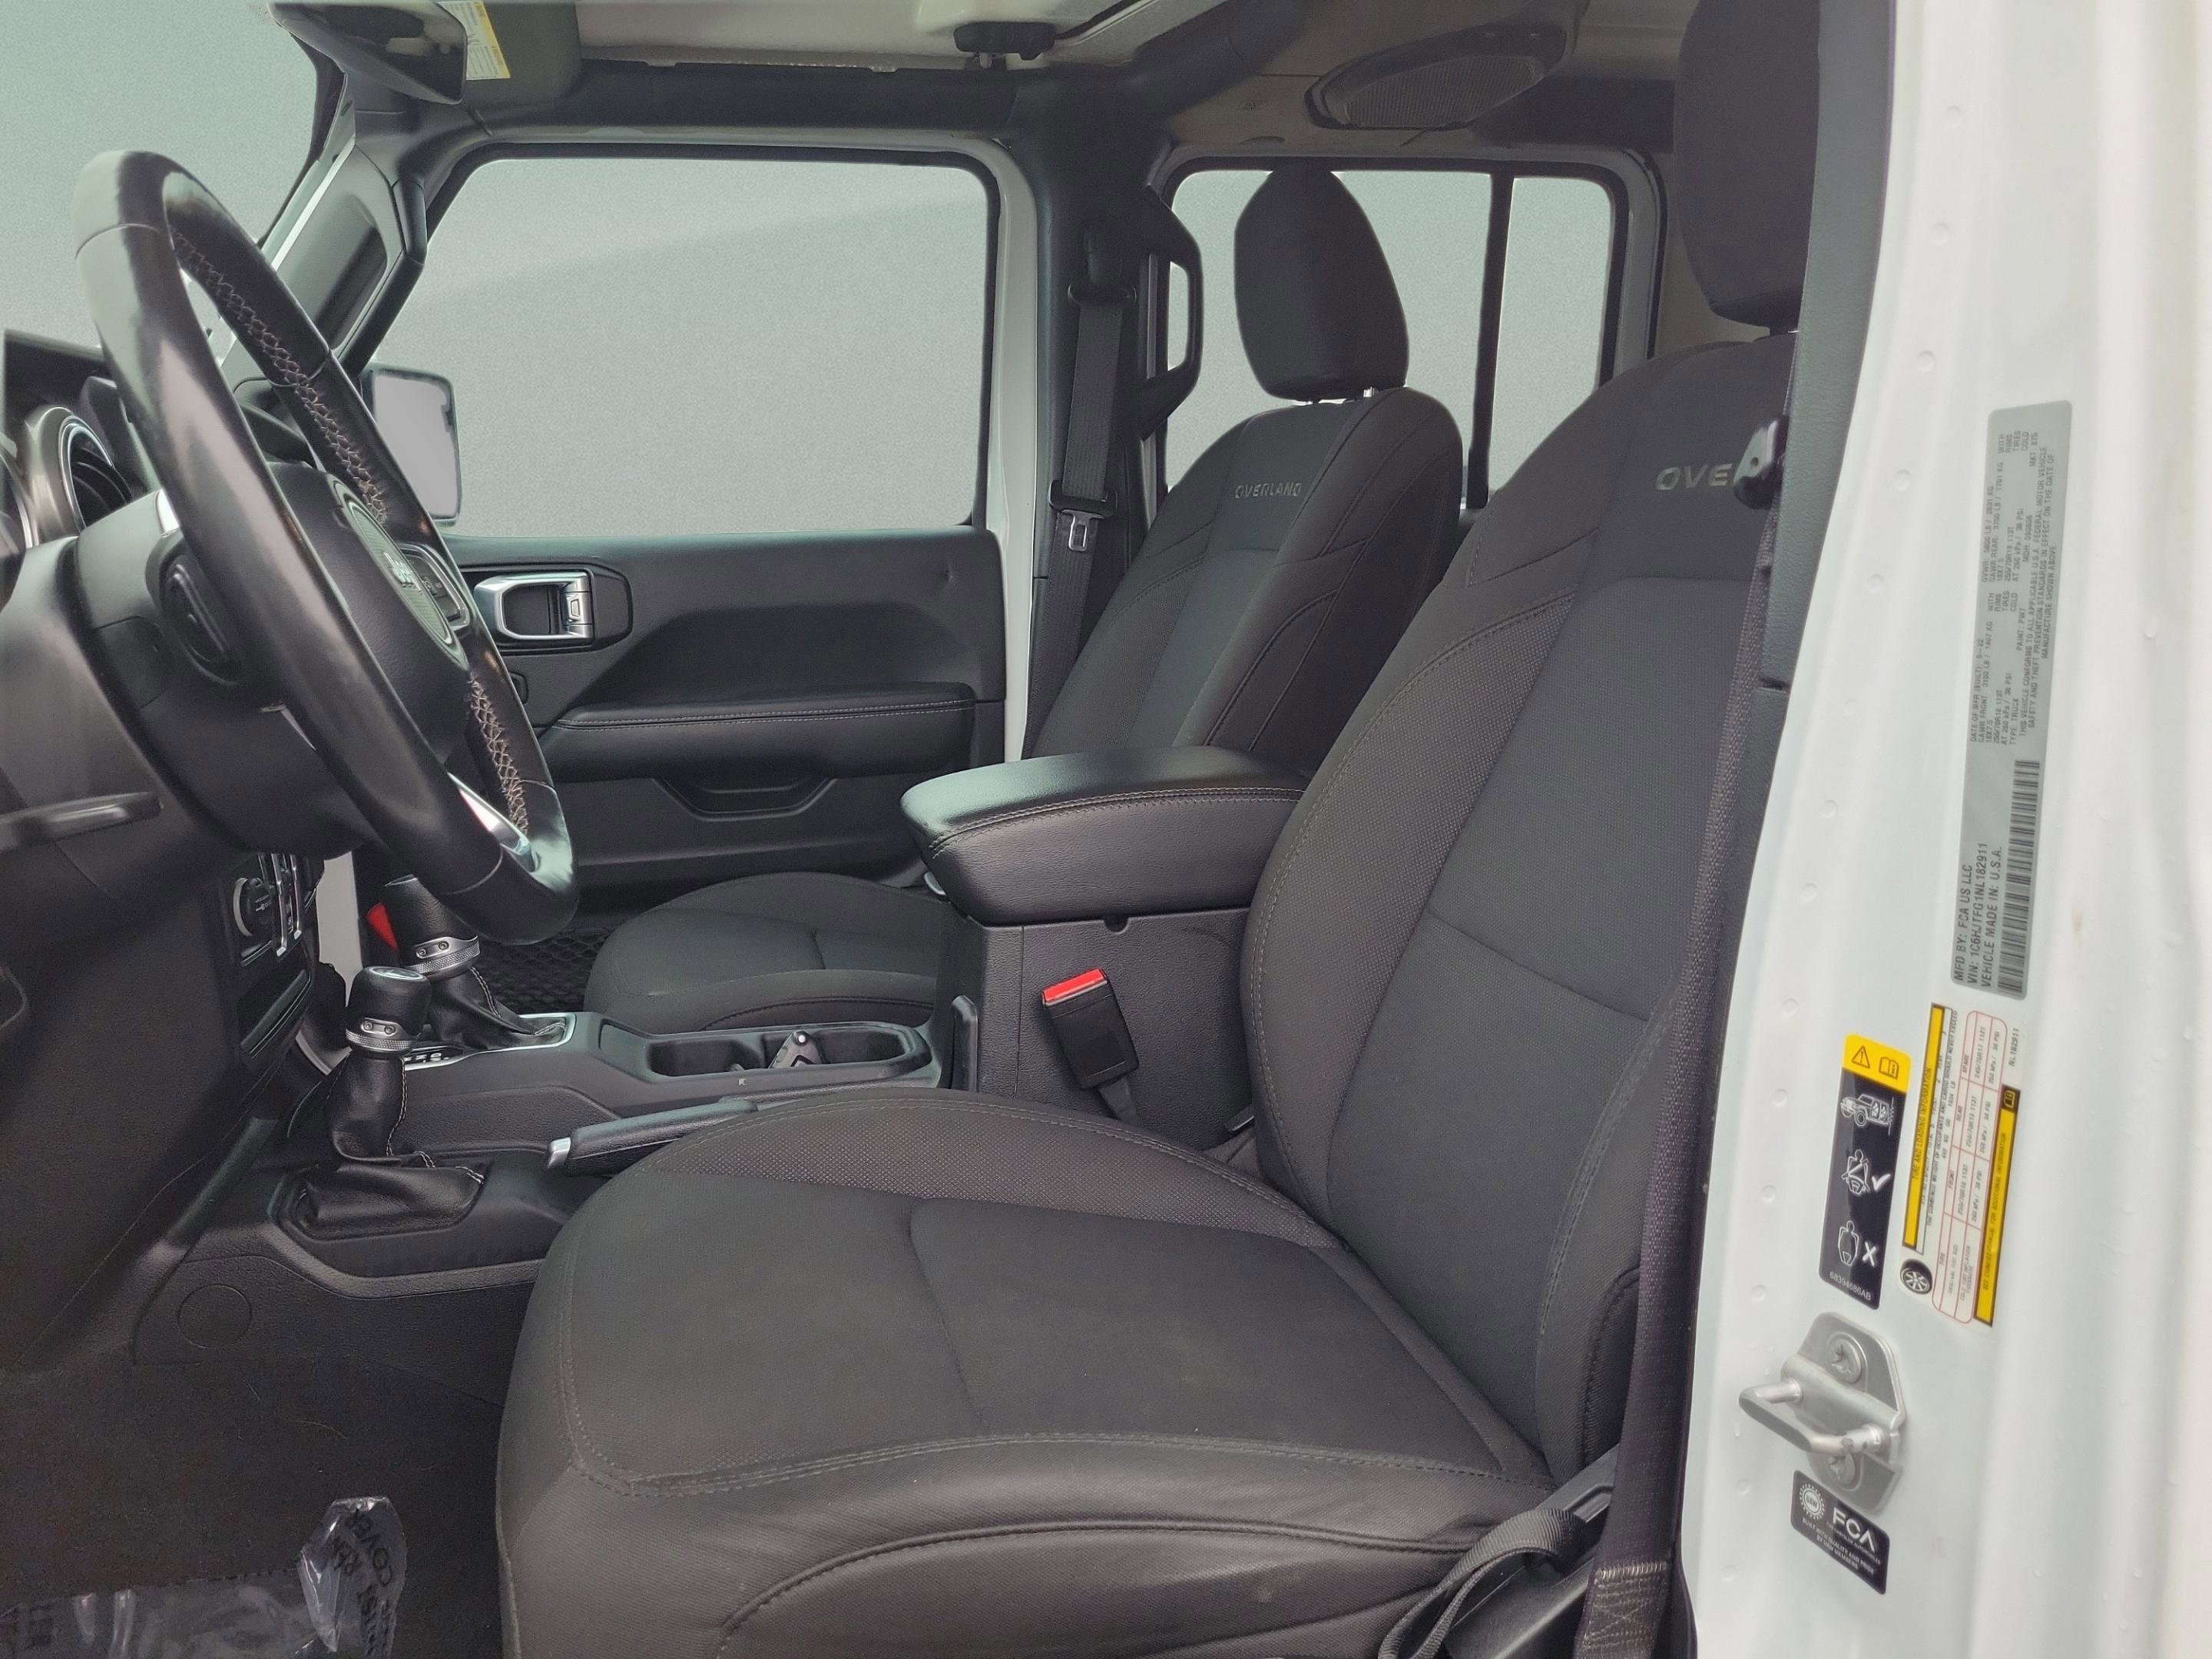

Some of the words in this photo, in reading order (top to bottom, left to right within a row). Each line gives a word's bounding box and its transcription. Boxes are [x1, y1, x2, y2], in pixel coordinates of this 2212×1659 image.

[2038, 446, 2046, 476] VEHICLE
[2047, 454, 2053, 463] OF
[1234, 482, 1302, 499] OVERLAND
[1655, 463, 1737, 491] OVE
[2043, 506, 2050, 515] ON
[2033, 510, 2041, 541] FEDERAL
[2041, 519, 2049, 546] EFFECT
[2028, 571, 2037, 614] APPLICABLE
[2037, 559, 2046, 604] STANDARDS
[2045, 573, 2054, 599] SHOWN
[2026, 634, 2032, 642] TO
[2033, 608, 2043, 653] PREVENTION
[2041, 603, 2051, 658] MANUFACTURE
[2022, 645, 2032, 685] CONFORMS
[1972, 712, 1979, 721] OF
[2020, 688, 2028, 717] VEHICLE
[2027, 700, 2036, 728] SAFETY
[1962, 864, 1972, 884] LLC
[1990, 846, 2002, 879] U.S.A.
[1960, 888, 1970, 902] US
[1970, 843, 1987, 957] 1C6HJTFG1NL182911
[1988, 885, 1998, 900] IN:
[1959, 906, 1969, 928] FCA
[1985, 904, 1997, 937] MADE
[1956, 933, 1967, 952] BY:
[1954, 955, 1965, 981] MFD
[1968, 961, 1978, 984] VIN:
[1982, 940, 1994, 988] VEHICLE
[2008, 1027, 2019, 1067] NL182911
[1919, 1067, 1932, 1115] INFORMATION
[1916, 1115, 1926, 1148] LOADING
[1913, 1147, 1922, 1163] AND
[1833, 1506, 1876, 1552] FCA
